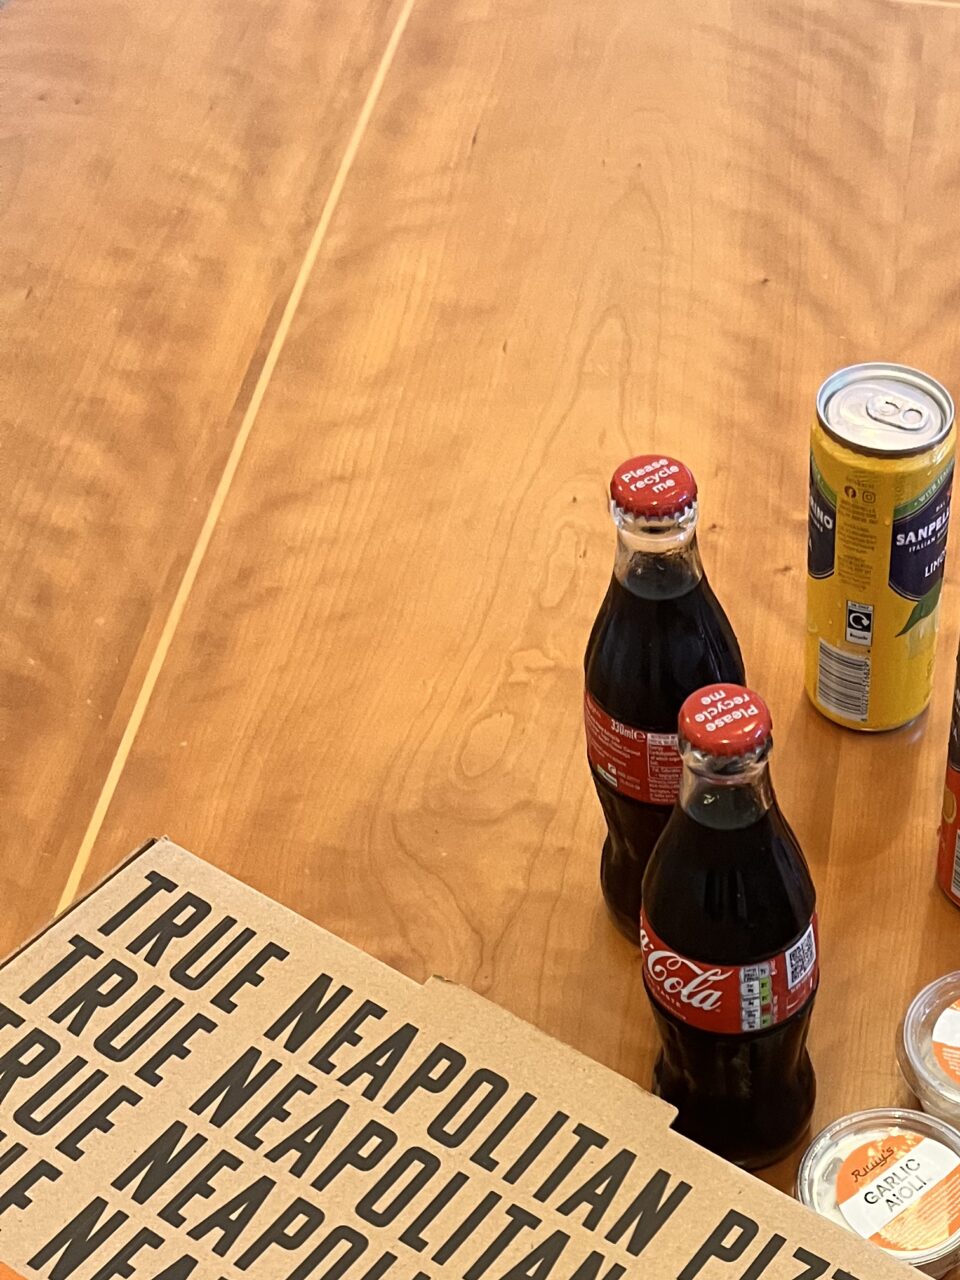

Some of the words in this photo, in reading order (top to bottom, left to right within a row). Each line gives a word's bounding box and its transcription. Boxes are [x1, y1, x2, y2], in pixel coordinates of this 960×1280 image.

[621, 459, 669, 483] Please
[629, 465, 680, 492] recycle
[652, 479, 676, 494] me
[694, 693, 750, 723] recycle
[701, 689, 727, 705] me
[705, 704, 759, 732] Please
[19, 934, 219, 1088] TRUE
[97, 870, 290, 1014] TRUE
[263, 973, 693, 1257] NEAPOLITAN
[0, 1003, 144, 1162] RUE
[864, 1157, 921, 1205] GARLIC
